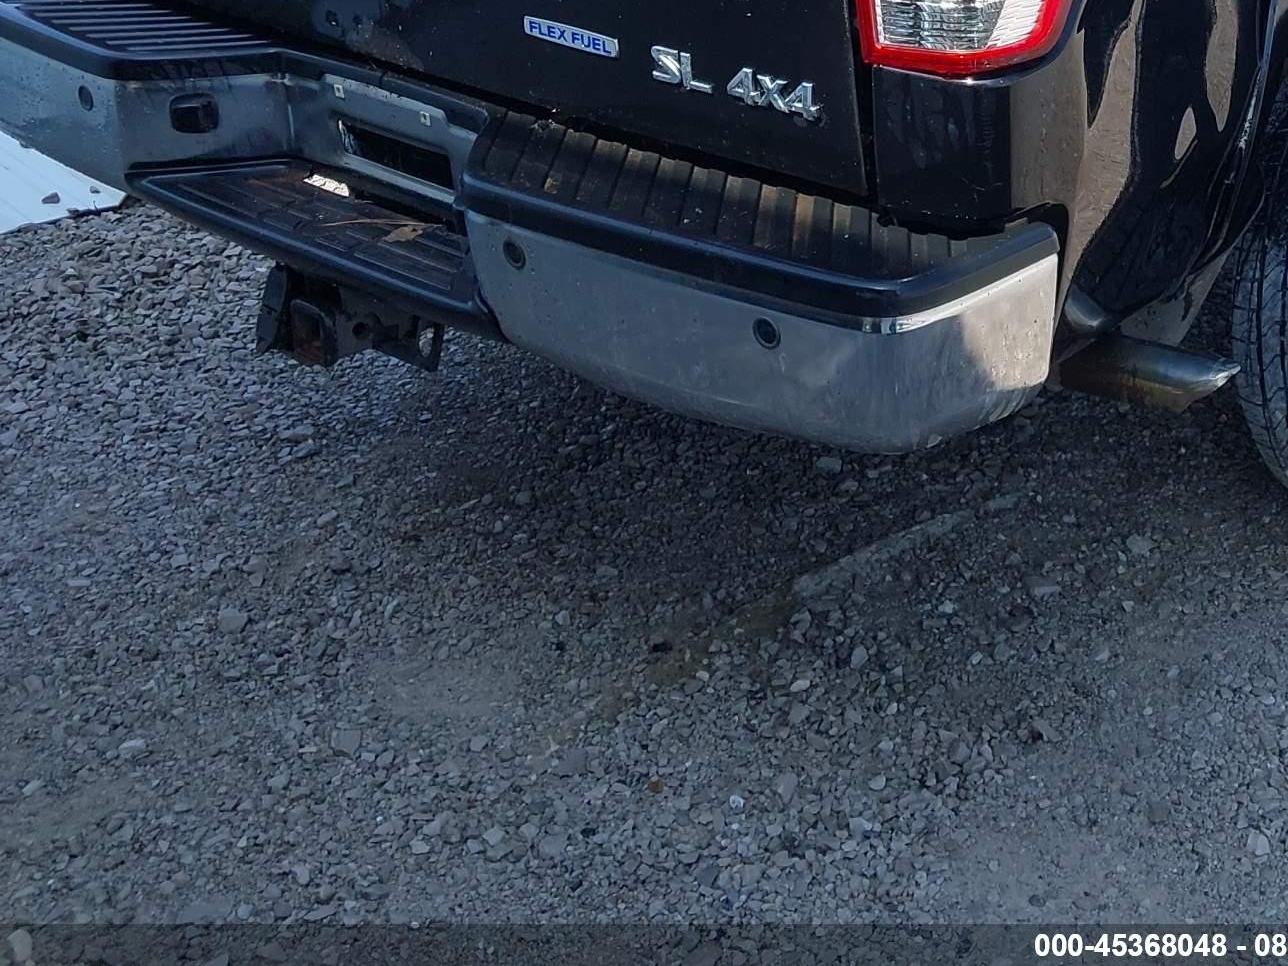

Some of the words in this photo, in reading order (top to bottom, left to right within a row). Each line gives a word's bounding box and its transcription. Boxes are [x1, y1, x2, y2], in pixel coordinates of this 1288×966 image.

[528, 20, 567, 42] FLEX
[571, 31, 612, 54] FUEL
[651, 45, 713, 94] SL
